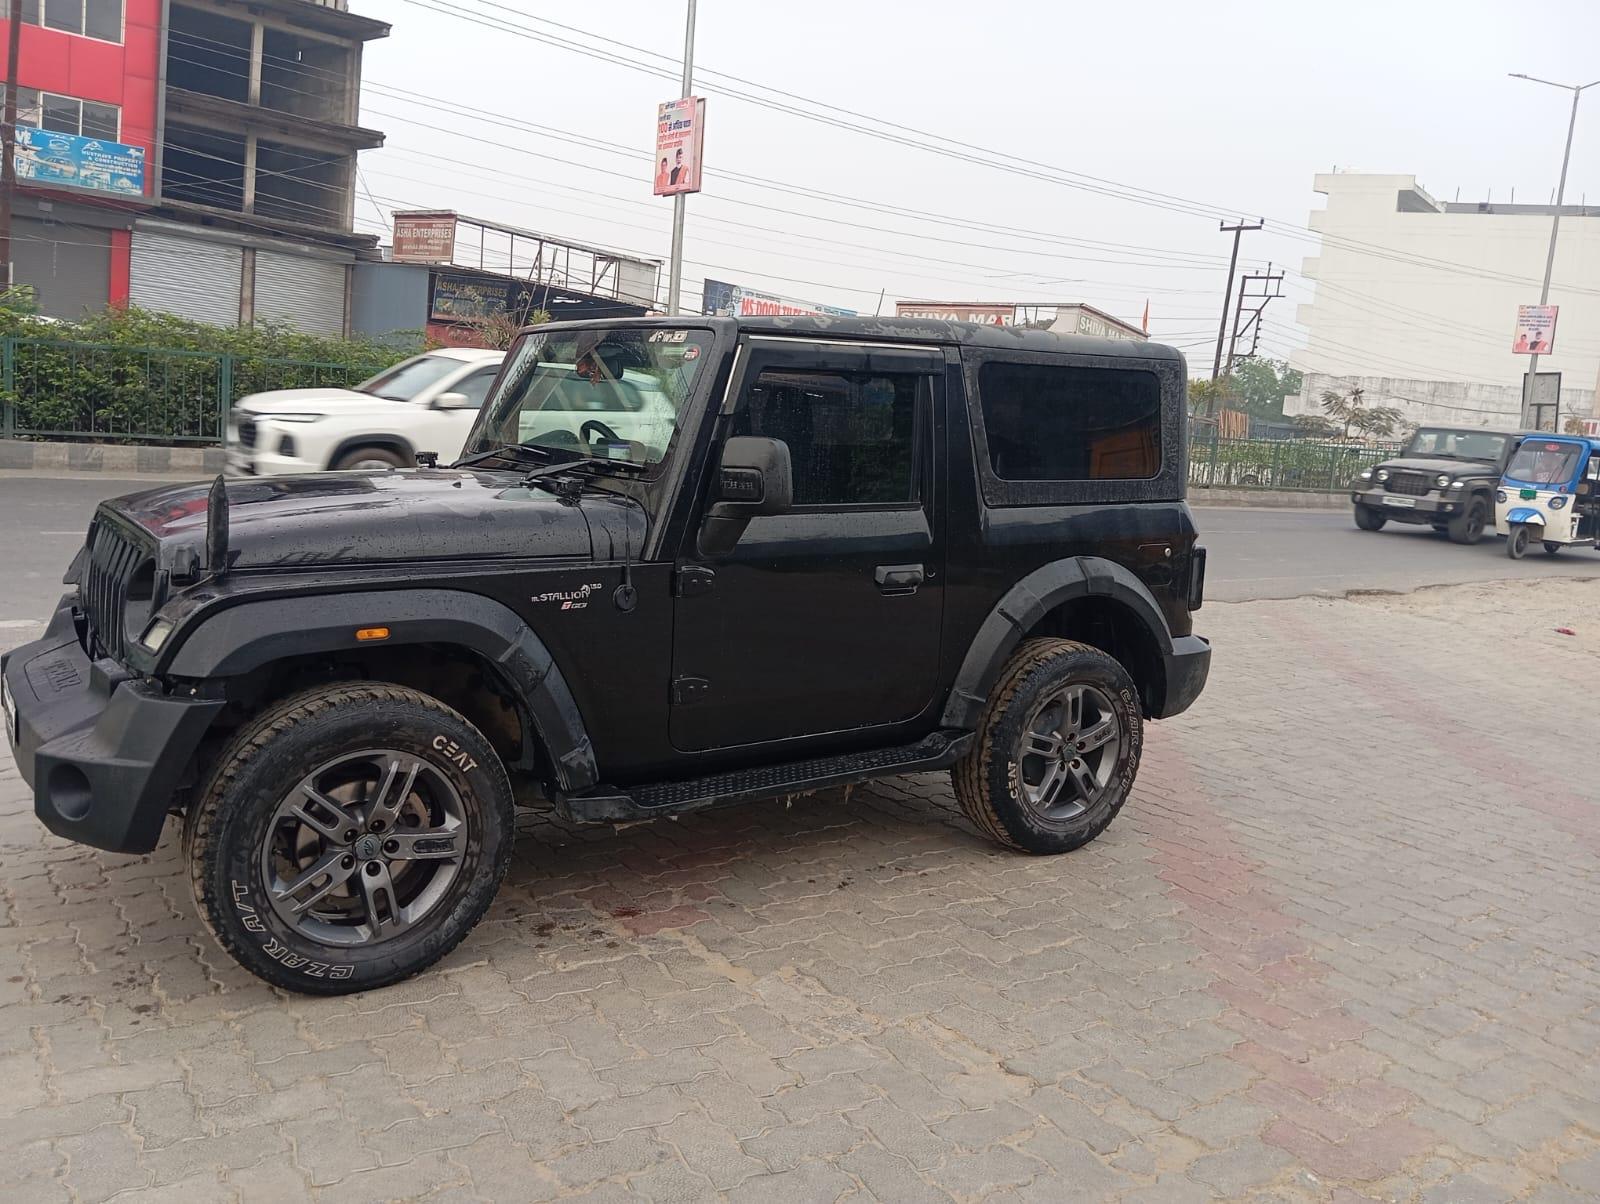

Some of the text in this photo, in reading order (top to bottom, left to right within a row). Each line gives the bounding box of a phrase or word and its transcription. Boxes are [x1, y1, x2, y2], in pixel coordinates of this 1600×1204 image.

[396, 227, 452, 239] ASHA ENTERPRISES
[437, 281, 457, 292] ASHA
[1080, 316, 1106, 337] SHIVA
[432, 735, 478, 773] CEAT
[1007, 760, 1019, 799] CEAT
[231, 879, 355, 980] CZAR A/T
